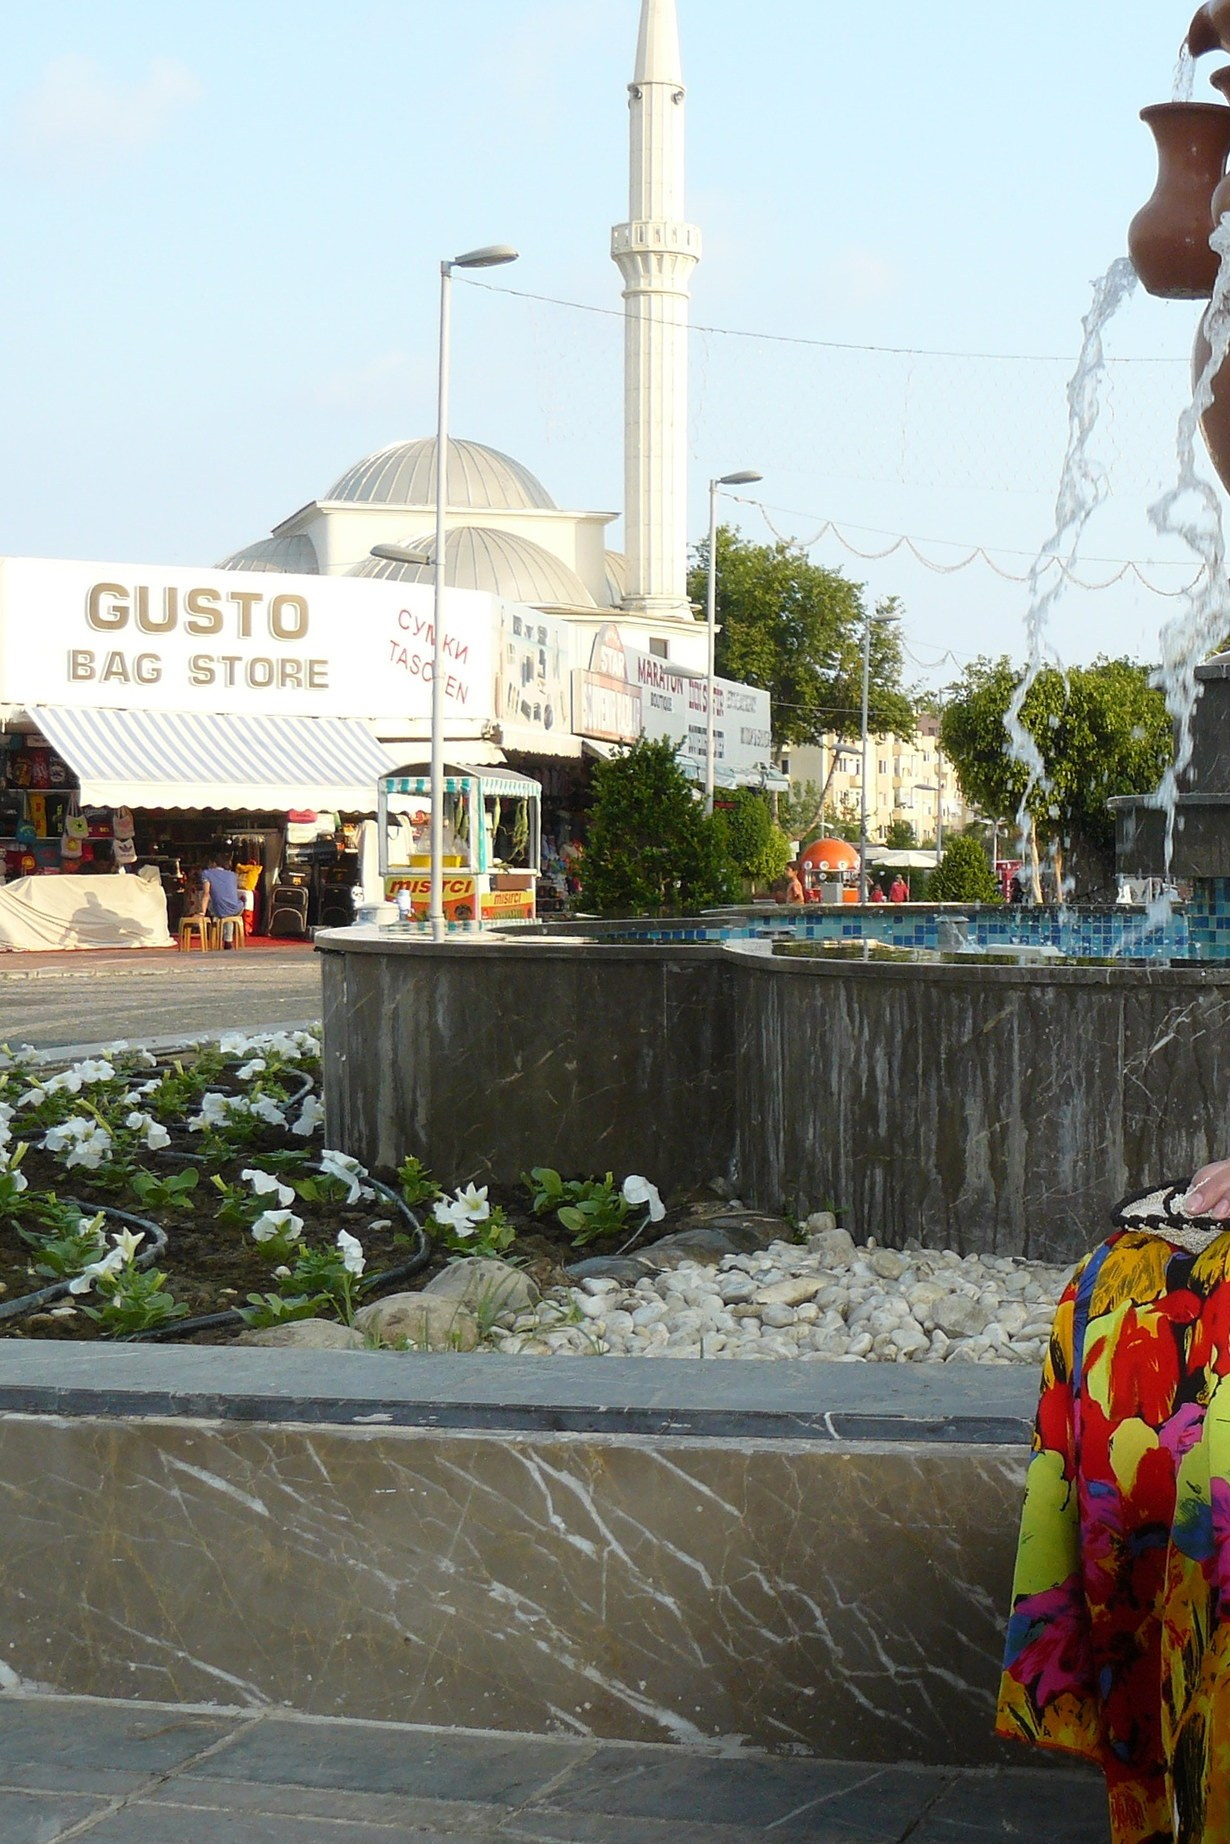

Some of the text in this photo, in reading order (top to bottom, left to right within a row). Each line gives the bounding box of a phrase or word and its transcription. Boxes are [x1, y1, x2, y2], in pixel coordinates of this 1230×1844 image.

[85, 582, 310, 641] GUSTO
[68, 649, 330, 690] BAG STORE
[390, 639, 469, 704] TASCEN
